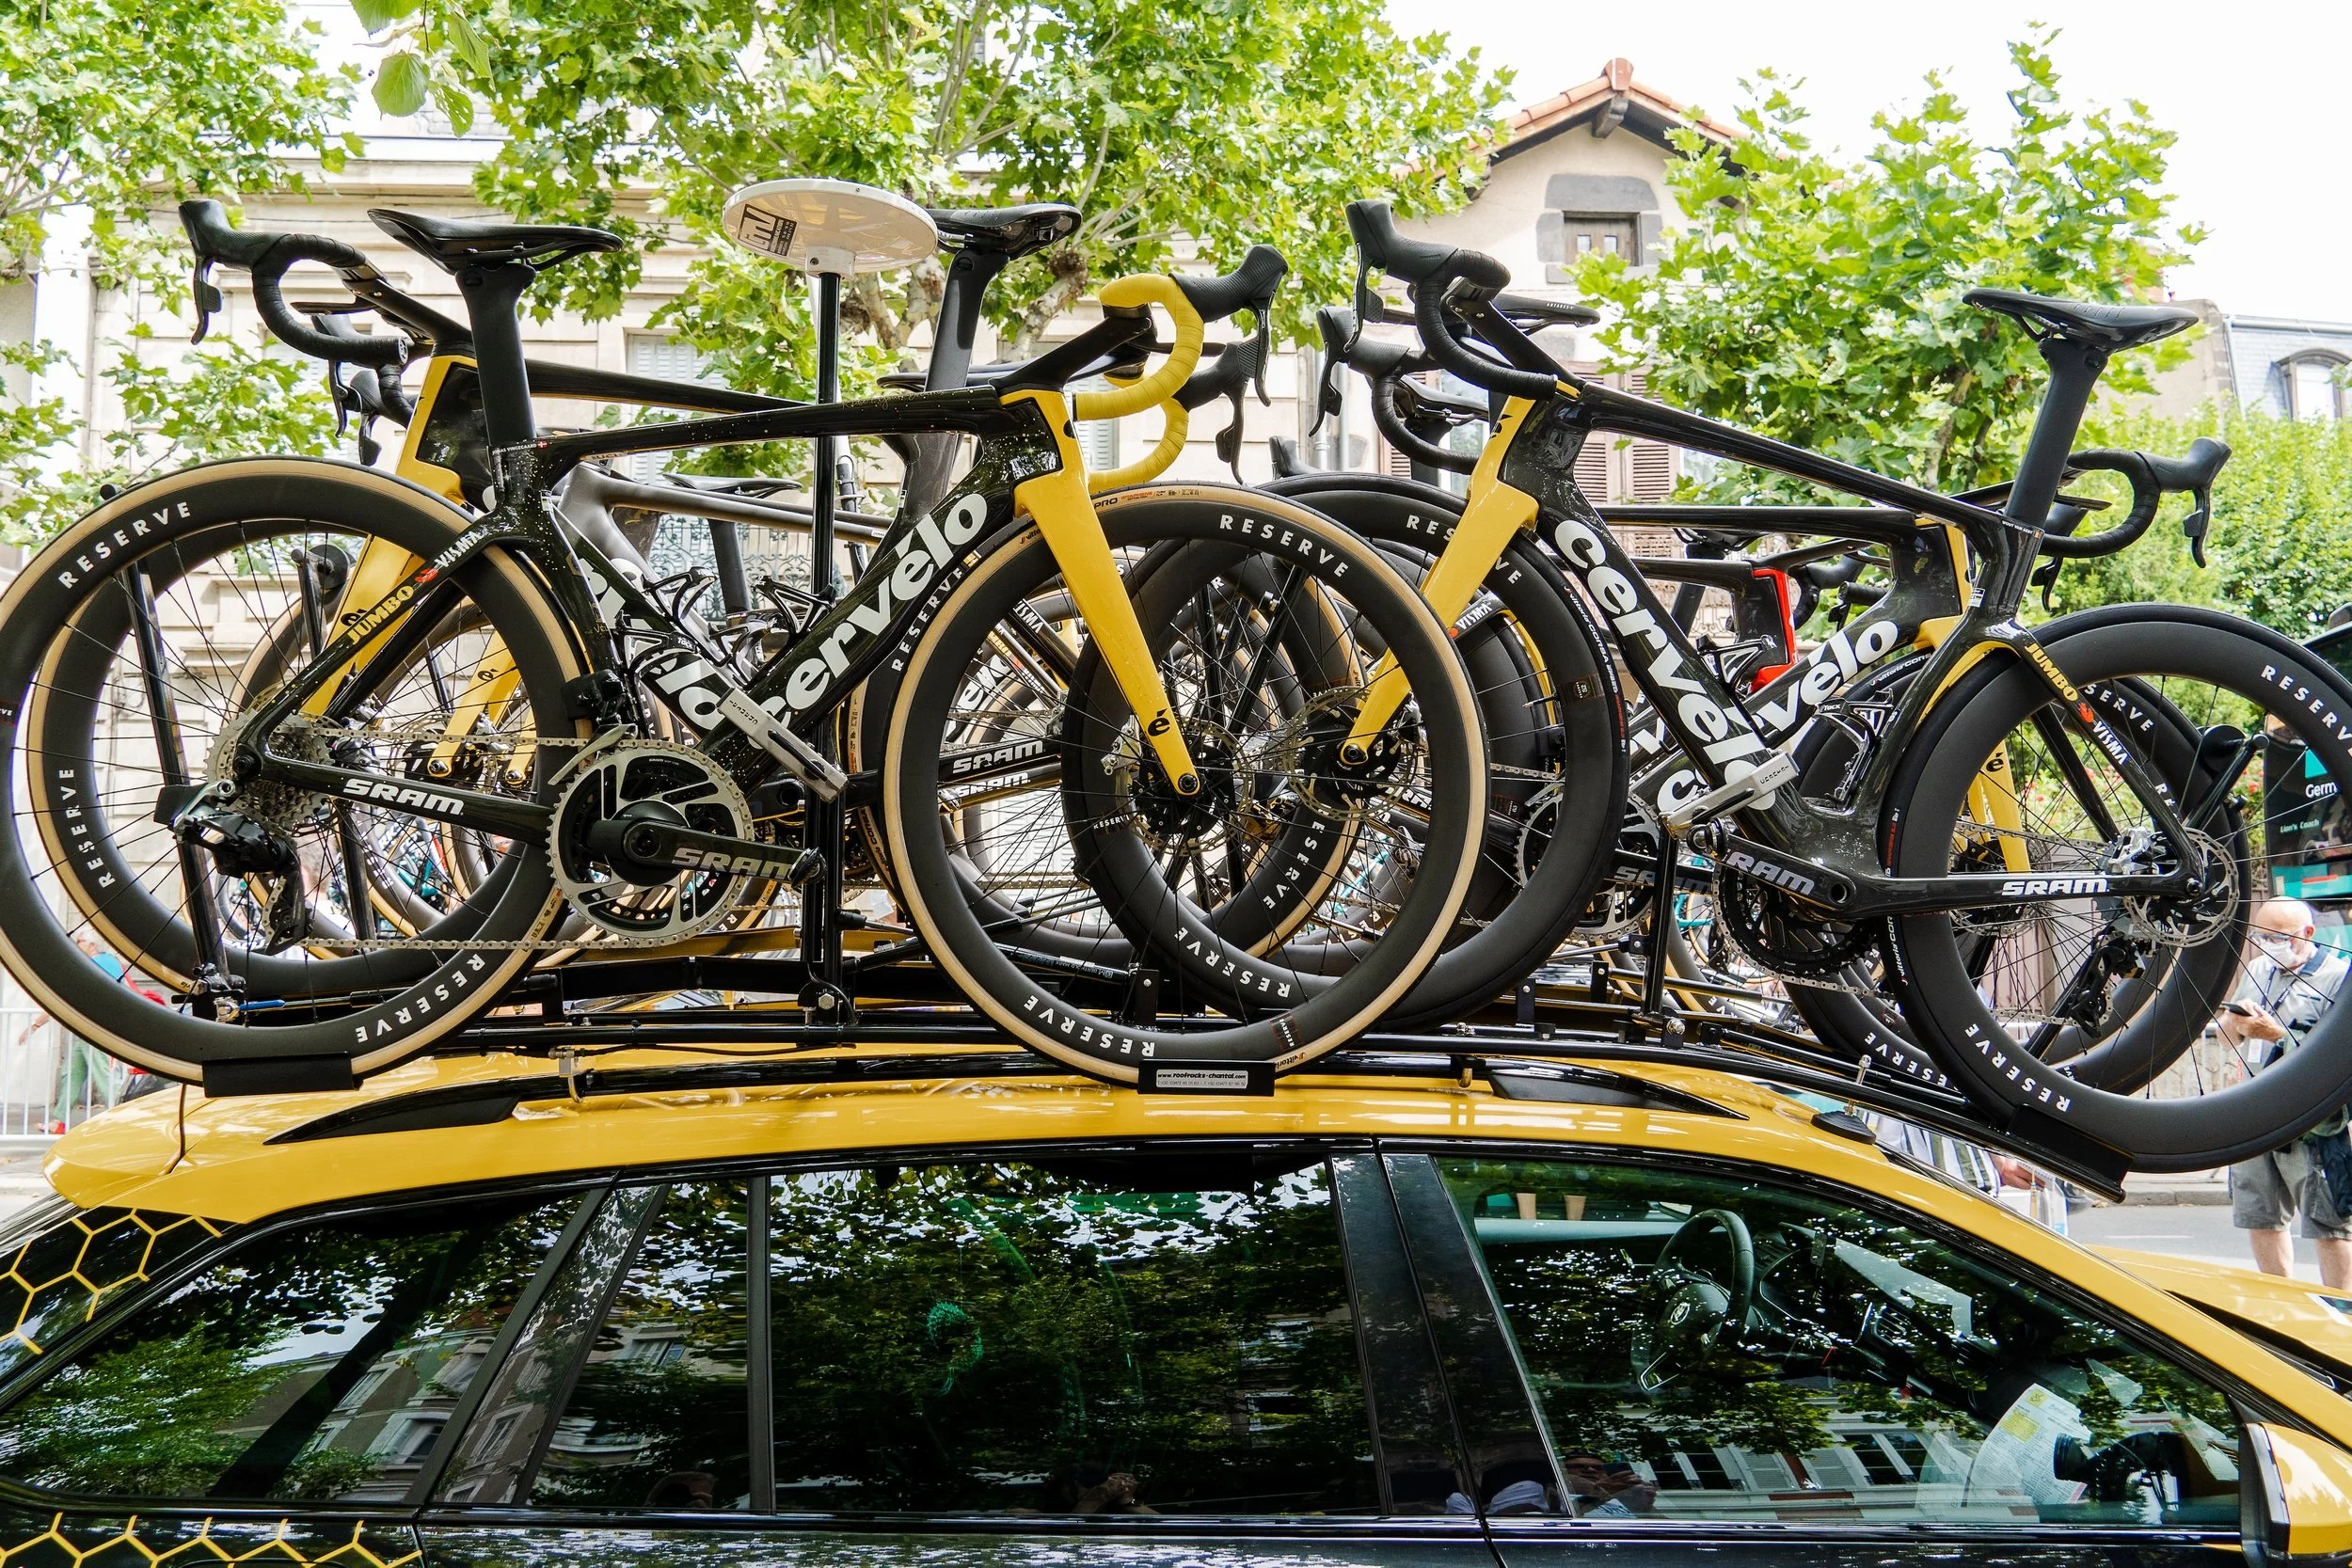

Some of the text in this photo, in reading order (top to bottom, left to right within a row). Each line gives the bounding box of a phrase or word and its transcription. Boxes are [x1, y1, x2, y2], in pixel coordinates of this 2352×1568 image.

[1094, 497, 1118, 509] PRO
[57, 499, 192, 589] RESERVE
[1025, 529, 1041, 540] vitto
[1219, 515, 1348, 578] RESERVE
[1406, 515, 1522, 584] RESVE
[346, 531, 482, 645] JUMBO VISMA
[1455, 602, 1493, 631] VISMA
[892, 567, 963, 672] RESERVE
[1569, 593, 1592, 625] vittoria
[1588, 624, 1609, 663] CORSA
[2025, 642, 2130, 766] JUMBO VISMA
[2084, 684, 2154, 732] SERVE
[2261, 664, 2352, 757] RESERV
[952, 740, 1043, 774] SRAM
[59, 767, 116, 888] RESERVE
[342, 778, 465, 816] SRAM
[672, 847, 794, 880] SRAM
[1721, 850, 1816, 895] RAM
[2001, 878, 2108, 896] SRAM
[1174, 927, 1291, 998] RESERVE
[1886, 915, 1905, 977] vittoria COR
[357, 953, 485, 1044] RESERVE
[1024, 994, 1155, 1057] RESERVE
[1279, 1018, 1295, 1048] RESERVE
[1864, 1032, 1949, 1088] ESERVE
[1157, 1071, 1247, 1080] www.roofracks-chantal.com
[1964, 1022, 2072, 1113] RESERVE
